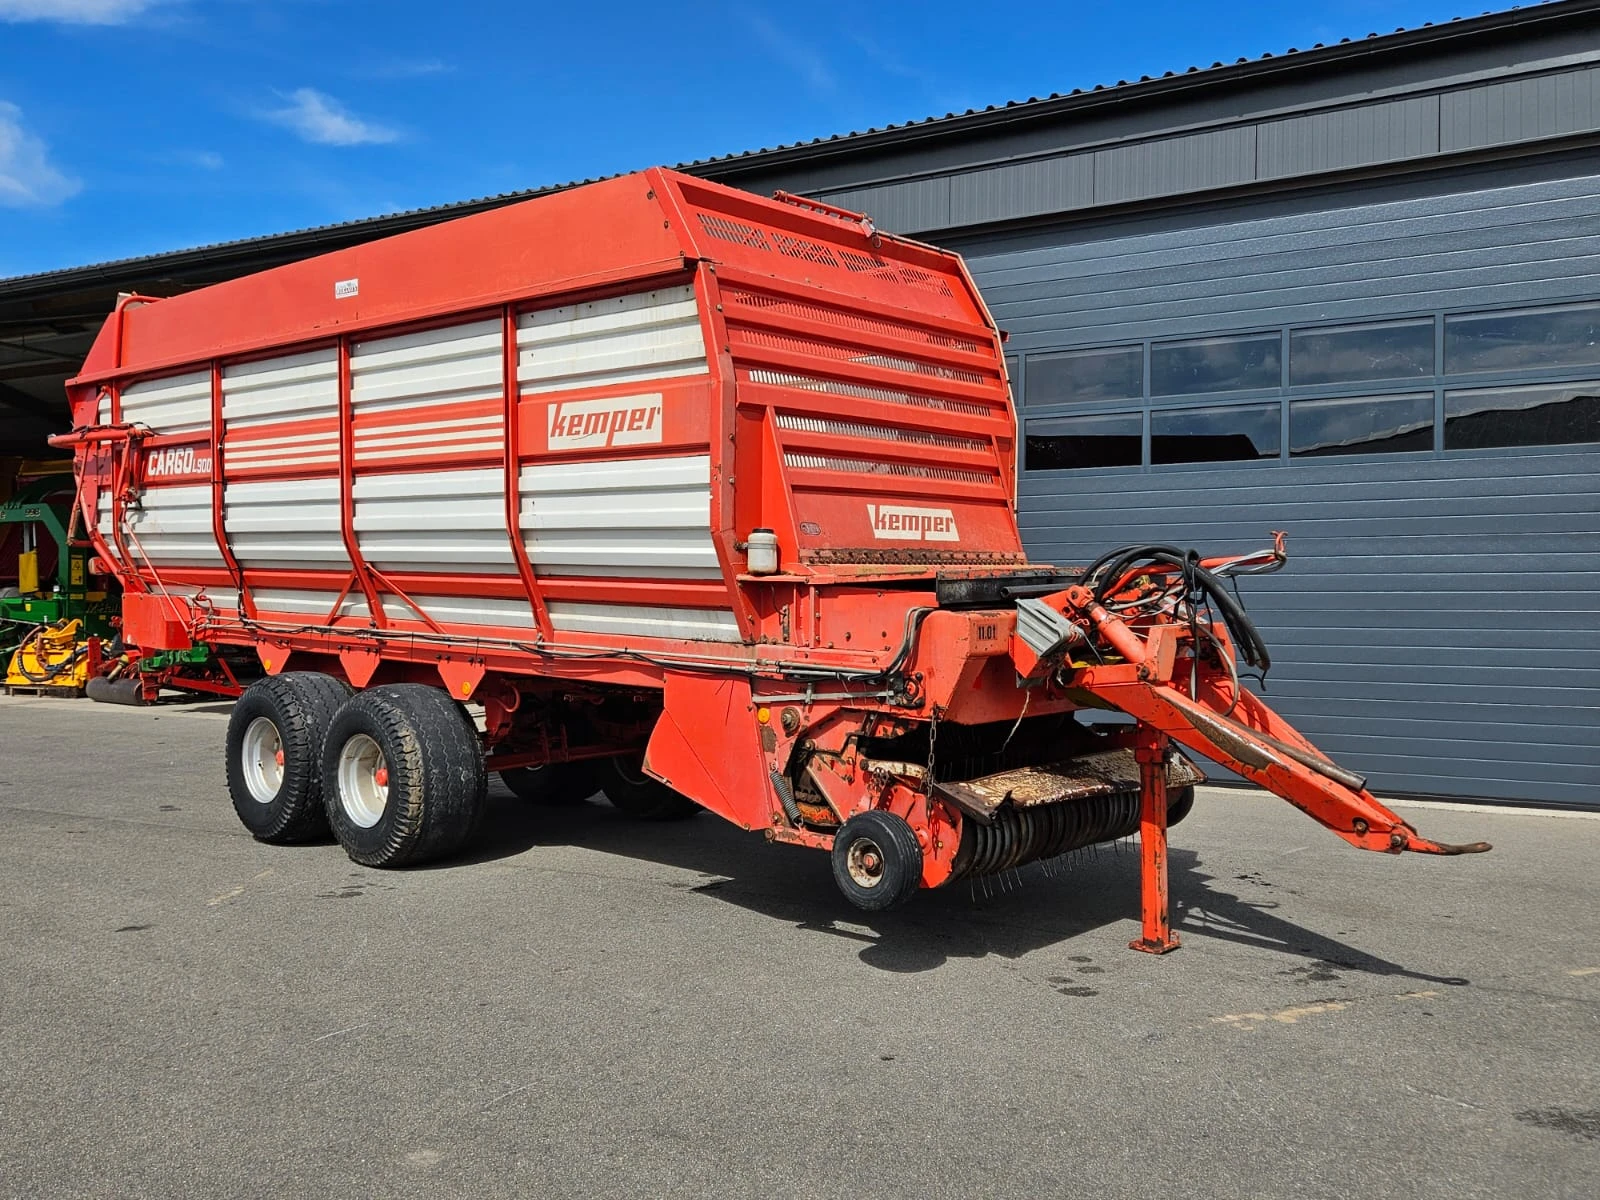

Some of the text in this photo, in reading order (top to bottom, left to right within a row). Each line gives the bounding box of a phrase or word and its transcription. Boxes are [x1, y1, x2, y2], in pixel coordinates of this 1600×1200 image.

[549, 403, 661, 448] kemper
[147, 447, 194, 477] CARGO
[874, 504, 954, 541] kemper
